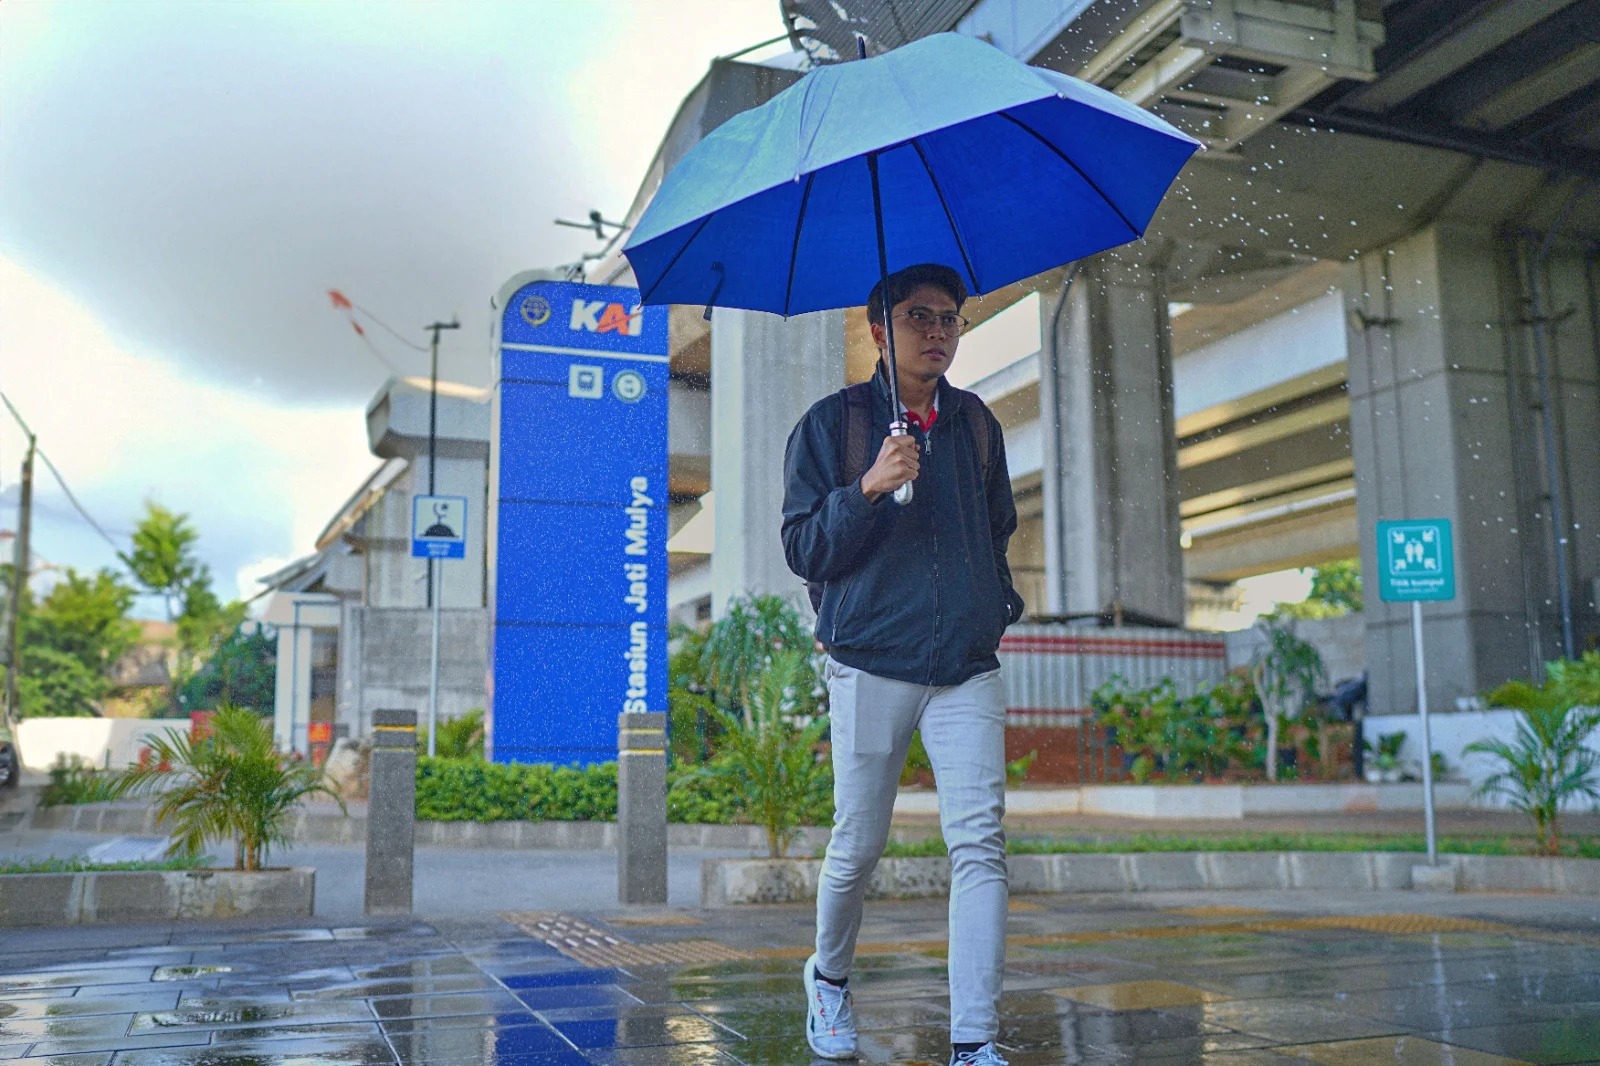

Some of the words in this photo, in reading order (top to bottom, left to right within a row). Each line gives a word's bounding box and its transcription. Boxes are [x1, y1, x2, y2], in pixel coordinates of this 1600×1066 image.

[569, 298, 643, 336] KAI
[625, 476, 654, 555] Mulya
[624, 563, 648, 613] Jati
[623, 621, 648, 713] Stasiun
